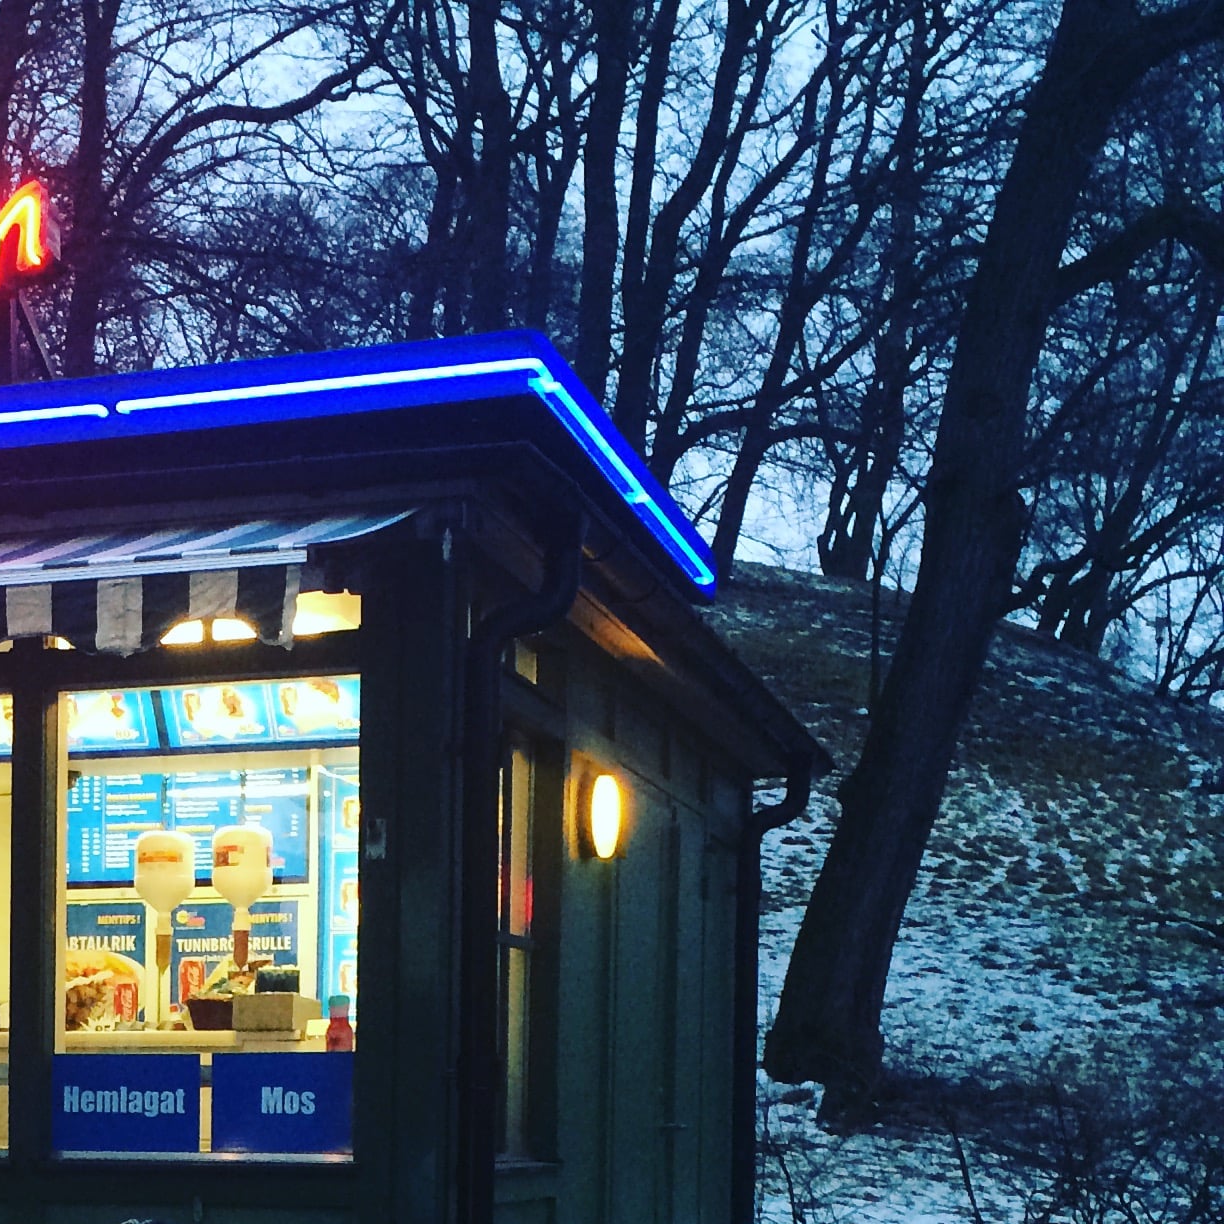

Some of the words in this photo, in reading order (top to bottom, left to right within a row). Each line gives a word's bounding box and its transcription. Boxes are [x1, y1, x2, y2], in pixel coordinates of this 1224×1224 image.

[176, 934, 293, 952] TUNNBRÖSRULLE
[63, 1085, 186, 1118] Hemlagat
[260, 1086, 317, 1115] Mos
